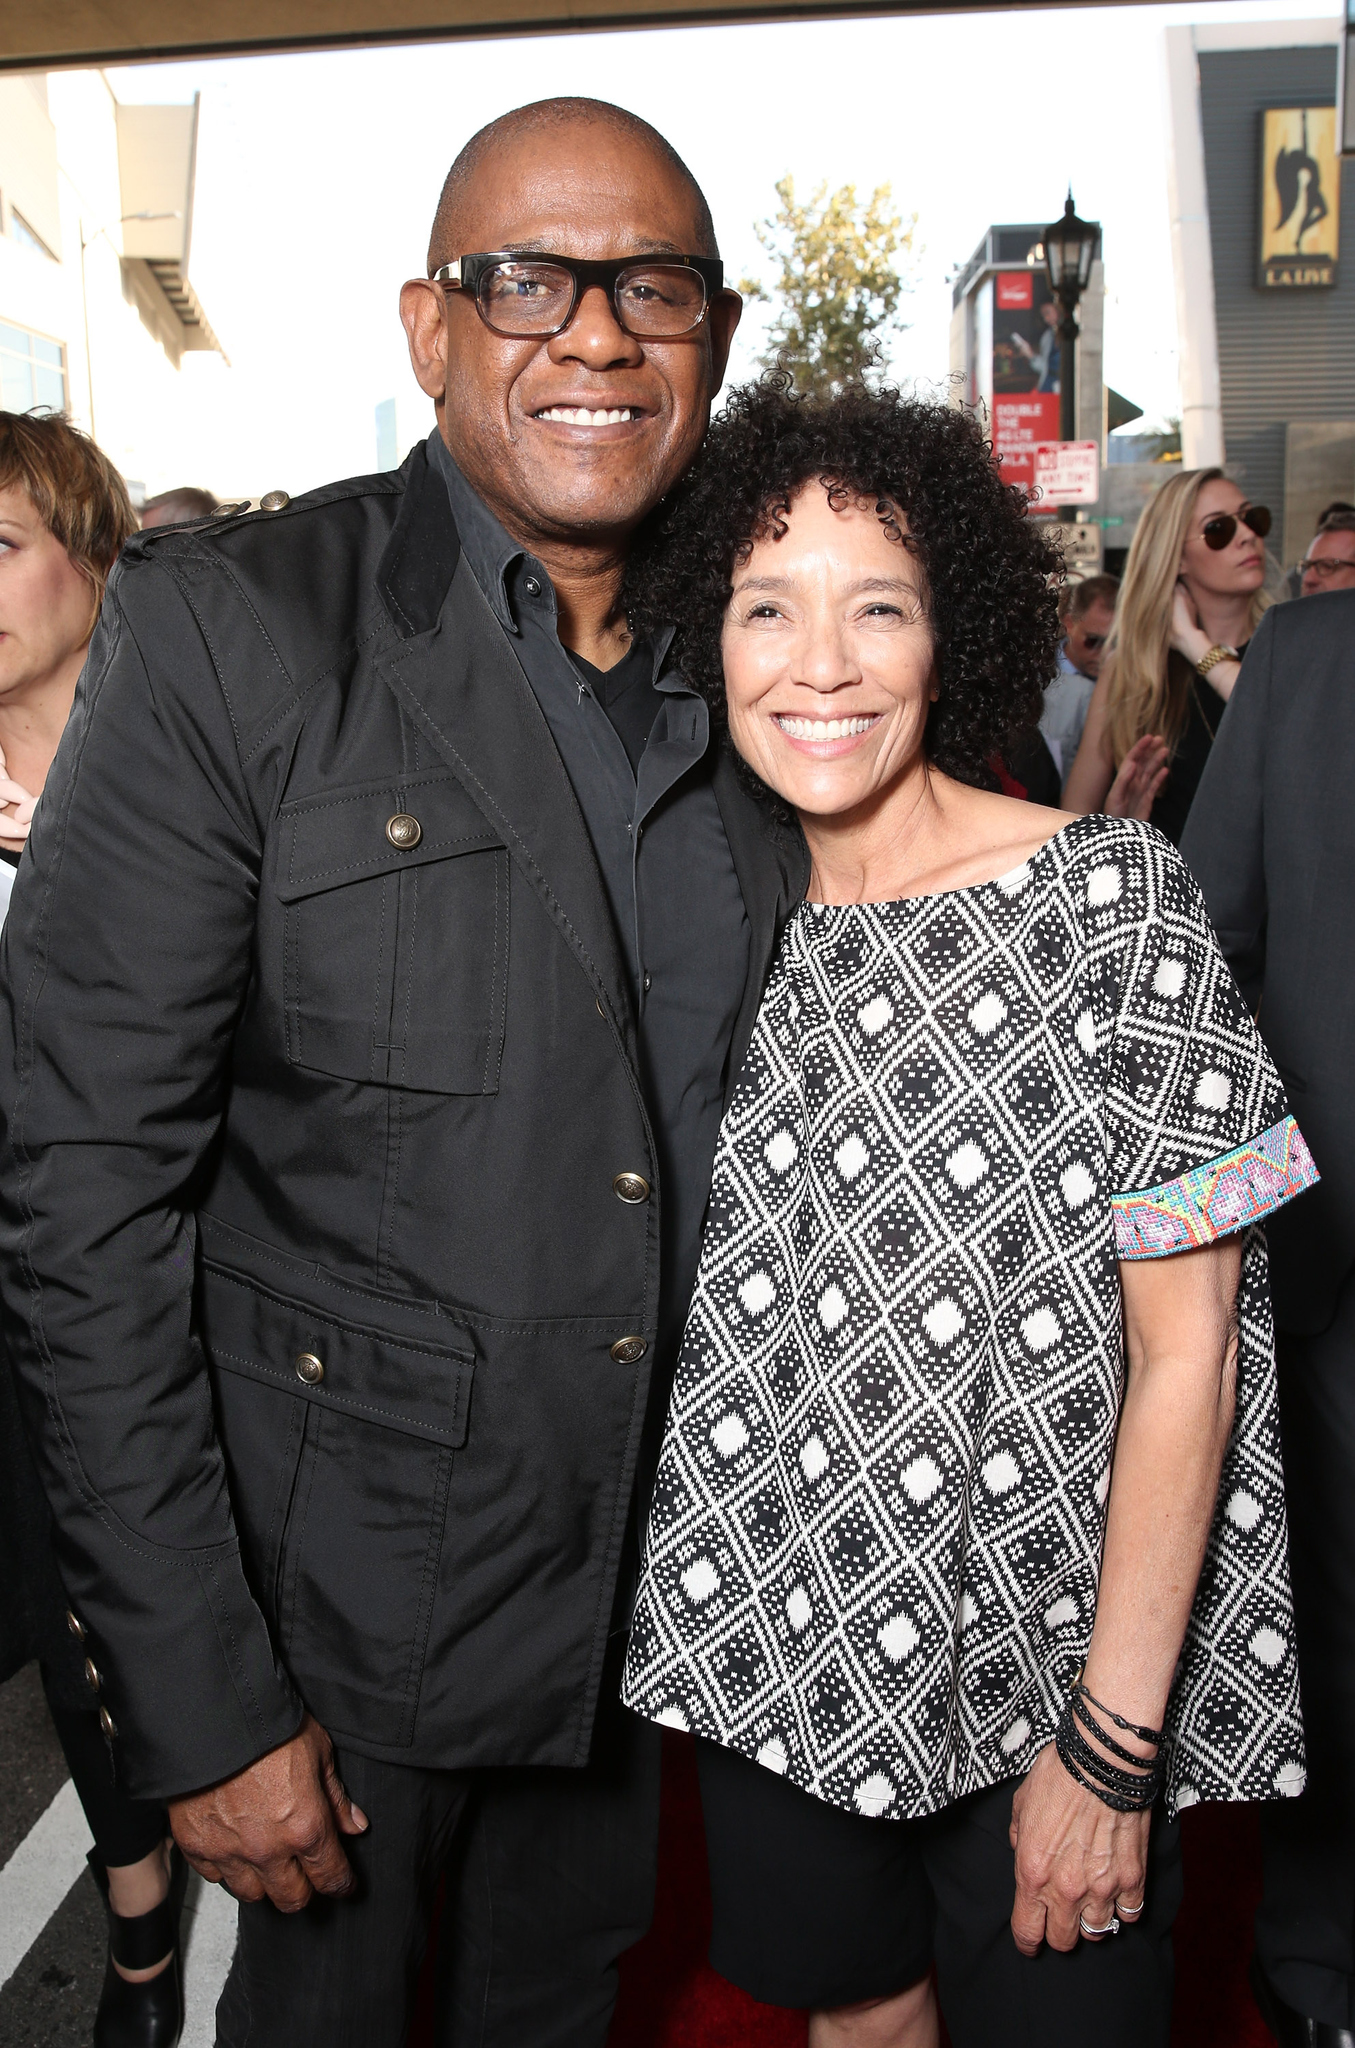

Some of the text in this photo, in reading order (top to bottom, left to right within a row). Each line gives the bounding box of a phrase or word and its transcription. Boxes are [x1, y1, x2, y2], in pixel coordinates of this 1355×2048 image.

[996, 404, 1041, 416] DOUBLE
[998, 416, 1018, 428] THE
[1013, 428, 1033, 441] LTE
[1039, 453, 1056, 469] NO
[1042, 471, 1090, 484] ANY TIME
